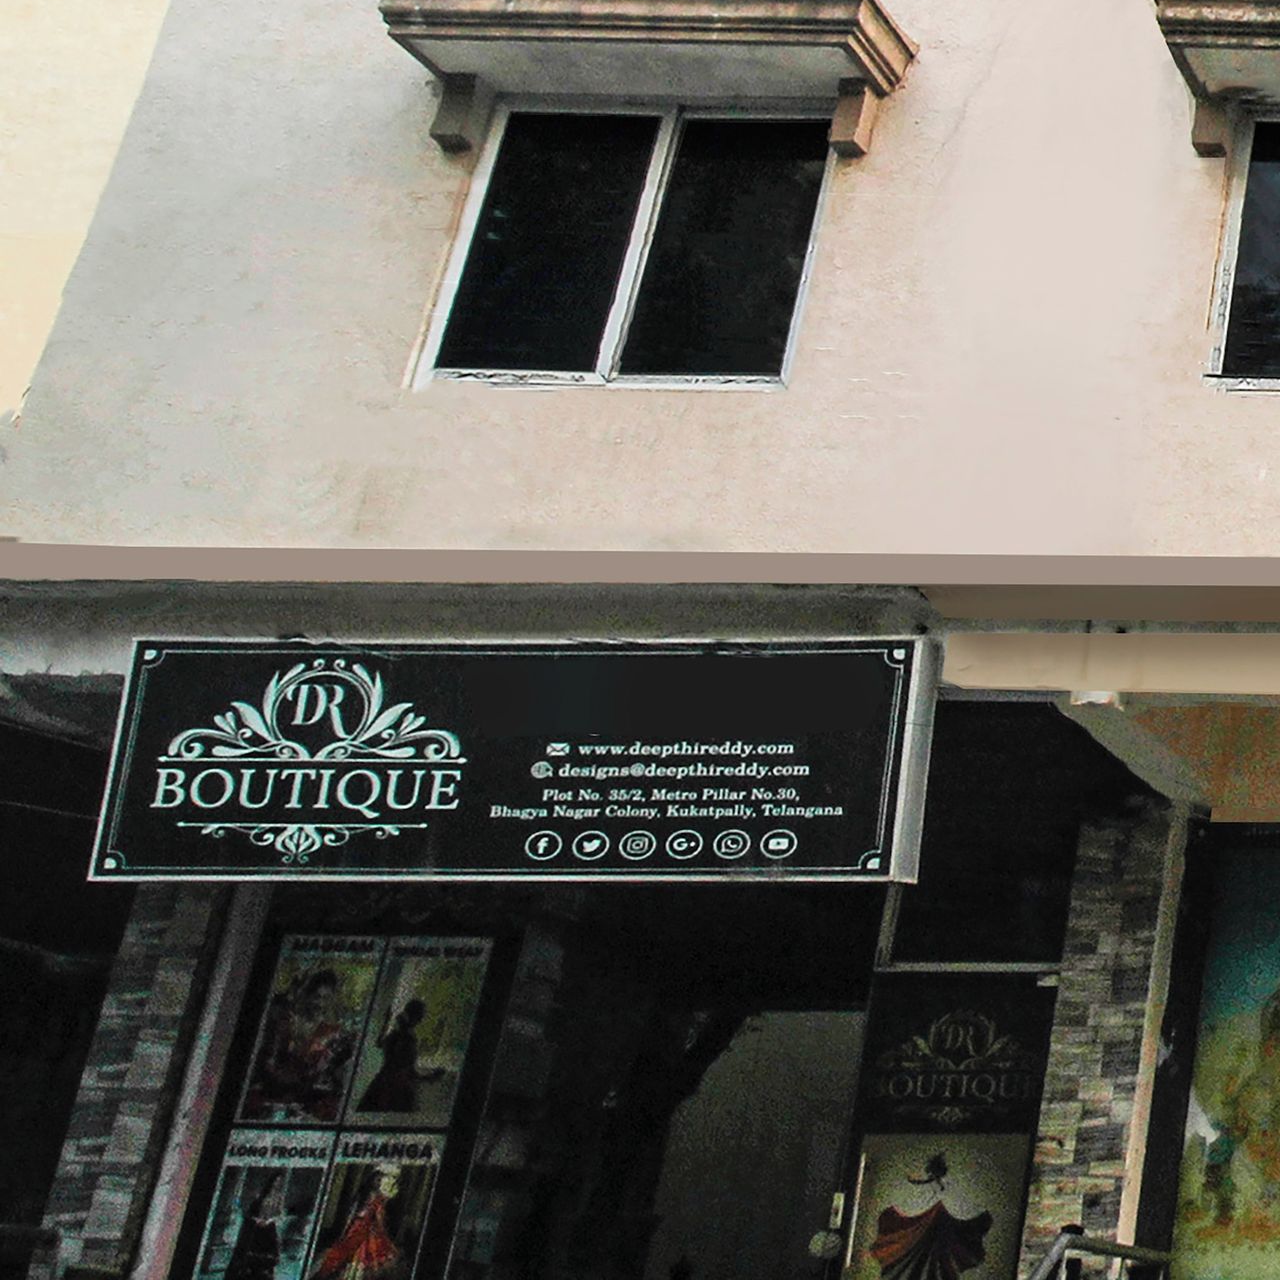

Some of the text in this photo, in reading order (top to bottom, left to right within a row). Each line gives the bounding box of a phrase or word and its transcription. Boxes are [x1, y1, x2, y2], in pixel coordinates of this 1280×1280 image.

[578, 742, 795, 757] www.deepthireddy.com
[558, 762, 811, 779] designs@deepthireddy.com
[150, 768, 462, 819] BOUTIQUE
[542, 788, 801, 804] Plot No. 35/2, Metro Pillar No.30,
[489, 804, 844, 821] Bhagya Nagar Colony, Kukatpally, Telangana
[342, 1141, 434, 1159] LEHANGA
